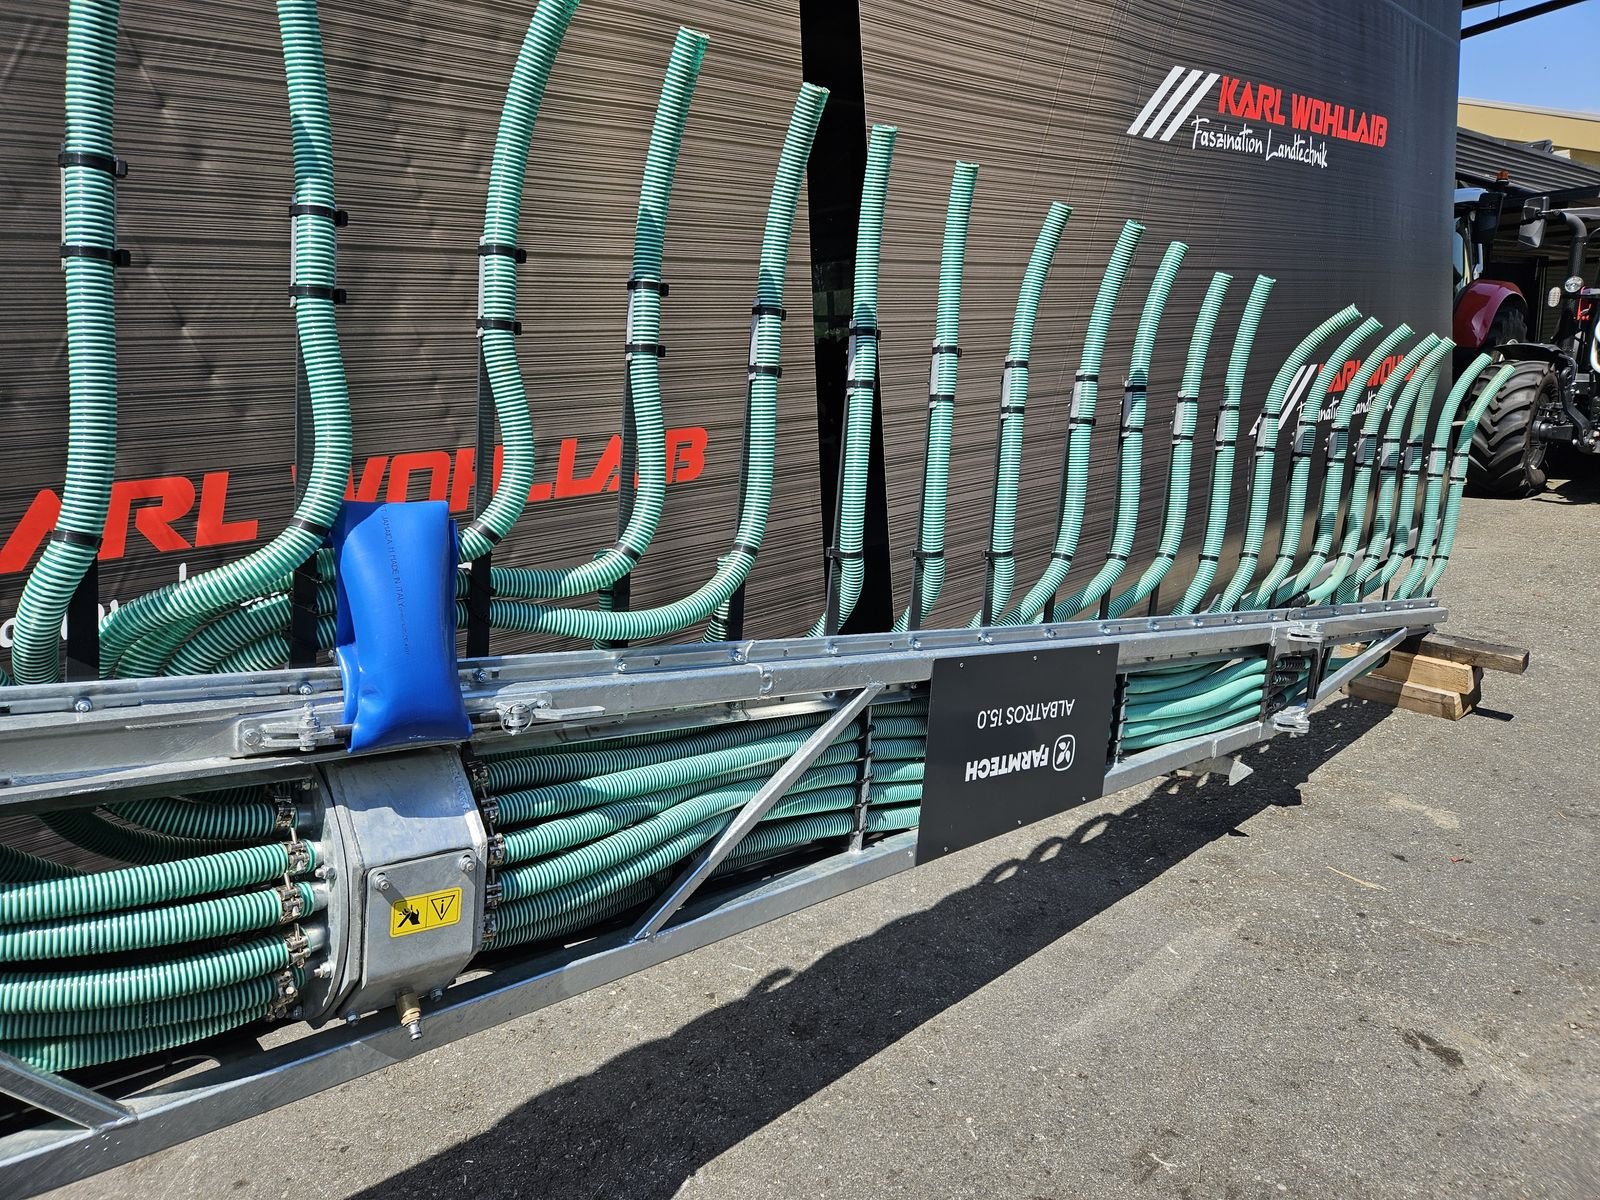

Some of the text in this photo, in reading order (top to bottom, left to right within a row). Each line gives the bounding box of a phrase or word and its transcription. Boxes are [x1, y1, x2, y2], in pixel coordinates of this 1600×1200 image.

[1218, 75, 1286, 126] KARL
[1191, 115, 1328, 168] Faszination Landtechnik
[977, 699, 1075, 729] ALBATROS 15.0
[964, 744, 1050, 782] FARMTECH
